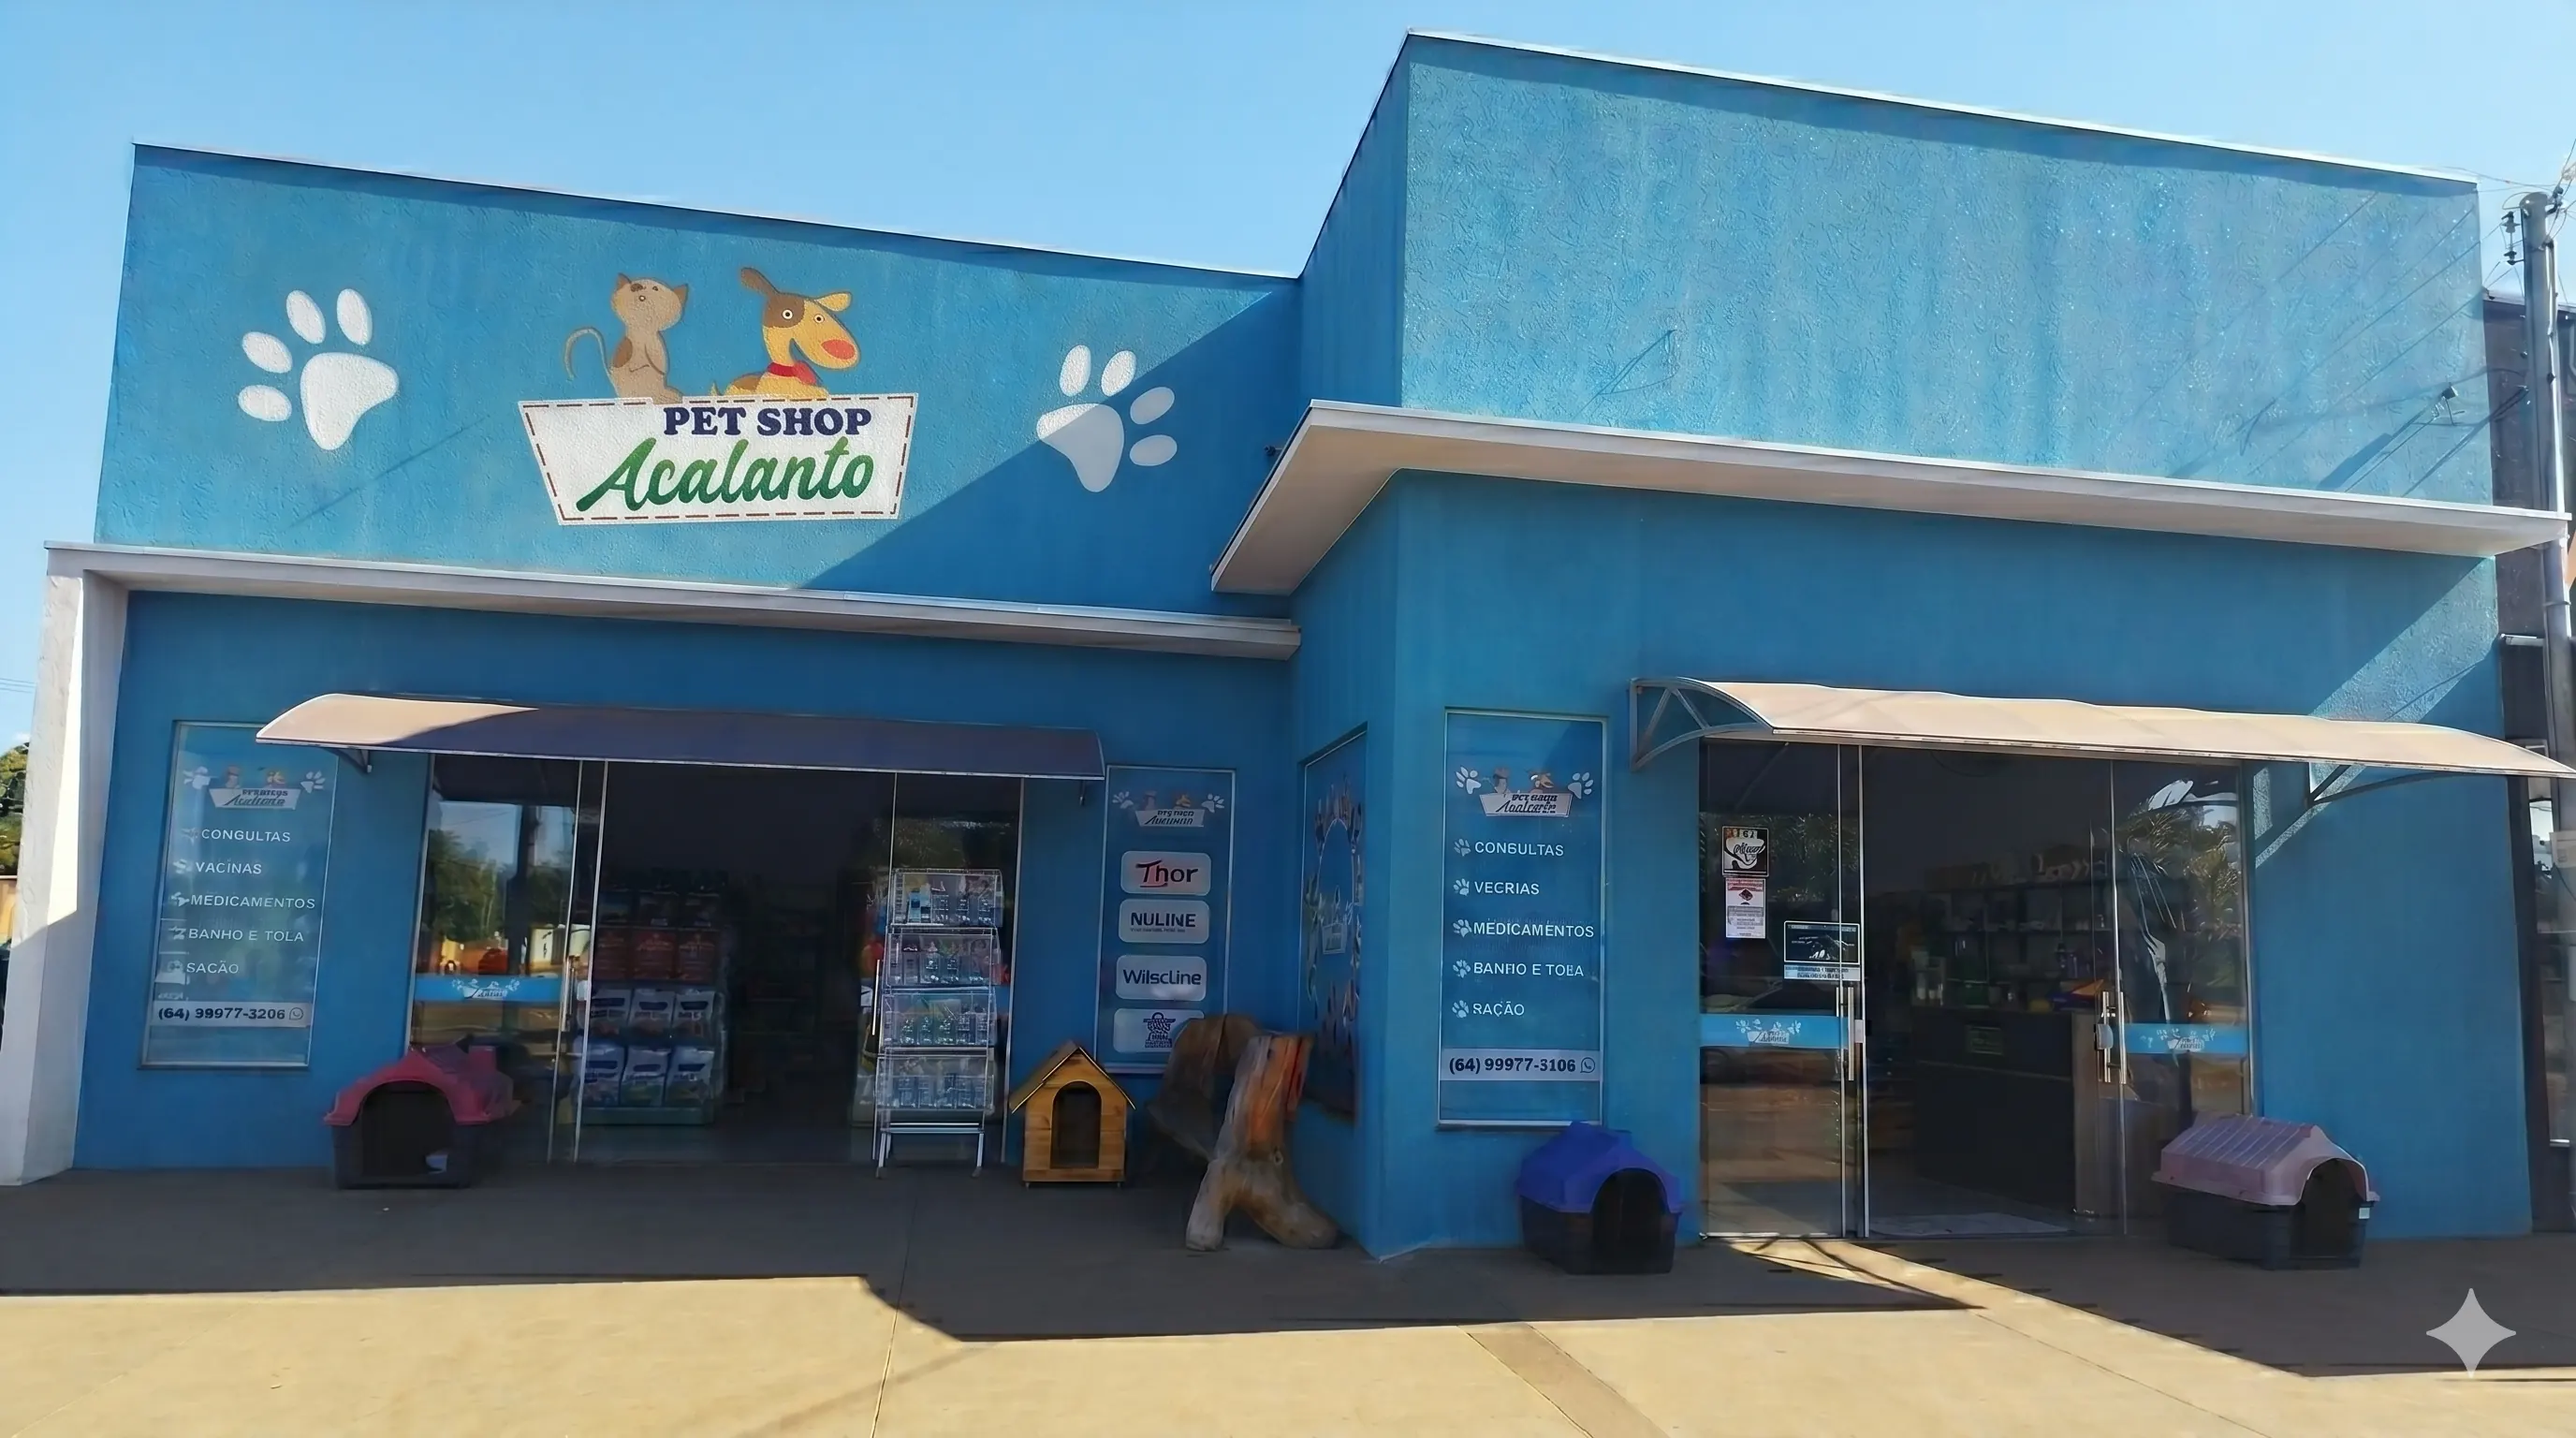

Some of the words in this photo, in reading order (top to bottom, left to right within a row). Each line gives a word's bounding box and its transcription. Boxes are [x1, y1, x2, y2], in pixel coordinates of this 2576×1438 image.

[664, 407, 746, 435] PET
[756, 407, 872, 436] SHOP
[577, 437, 873, 511] Acalanto
[195, 861, 262, 874] VACINAS
[1135, 859, 1199, 888] Thor
[1474, 881, 1540, 895] VECRIAS
[190, 894, 315, 909] MEDICAMENTOS
[1131, 912, 1196, 928] NULINE
[188, 928, 243, 941] BANHO
[248, 931, 258, 941] E
[265, 931, 304, 942] TOLA
[1473, 921, 1594, 938] MEDICAMENTOS
[1532, 964, 1542, 976] E
[158, 1007, 190, 1021] (64)
[1449, 1057, 1481, 1074] (64)
[1485, 1058, 1576, 1072] 99977-3106
